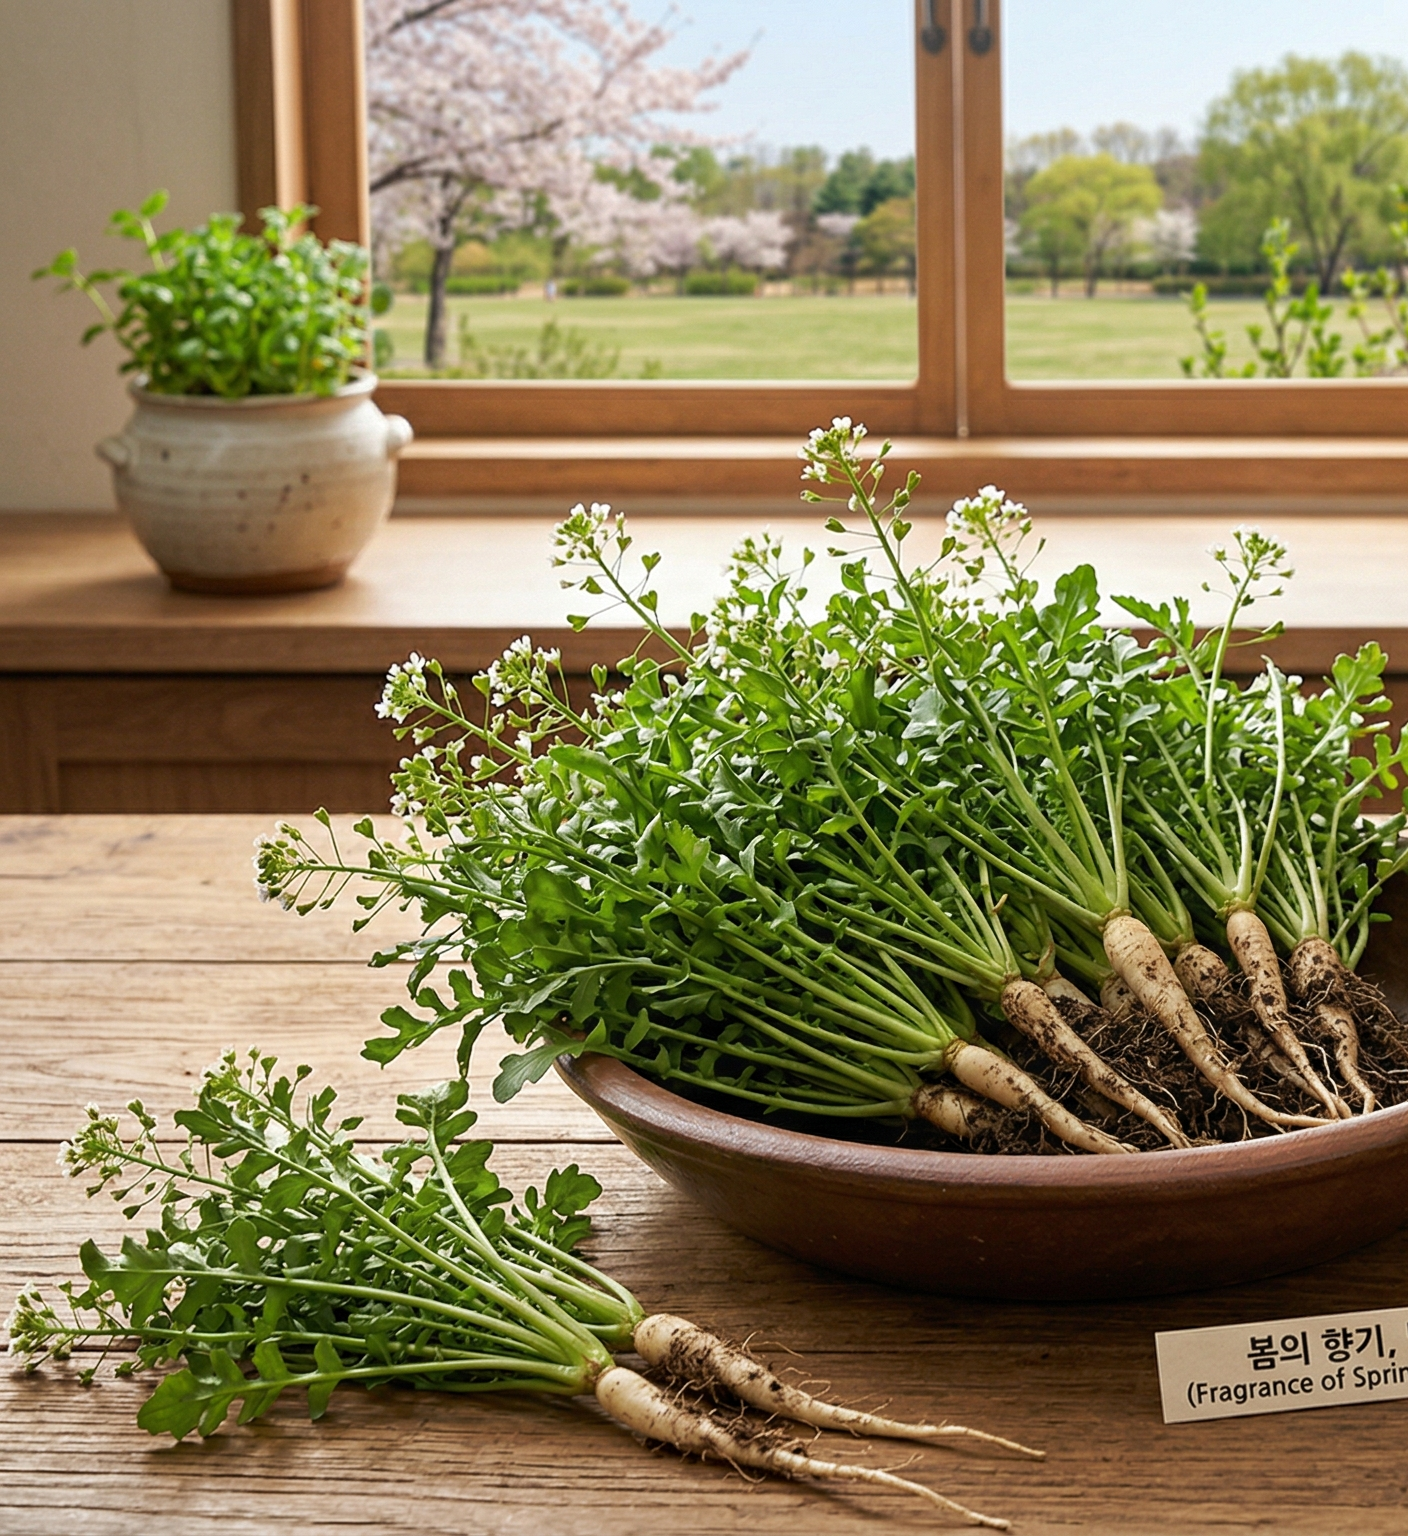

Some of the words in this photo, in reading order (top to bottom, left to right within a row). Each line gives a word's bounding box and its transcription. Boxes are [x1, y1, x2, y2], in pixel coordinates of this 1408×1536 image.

[1246, 1330, 1311, 1371] 봄의
[1320, 1323, 1397, 1364] 향기,
[1187, 1376, 1314, 1409] (Fragrance
[1321, 1366, 1346, 1392] of
